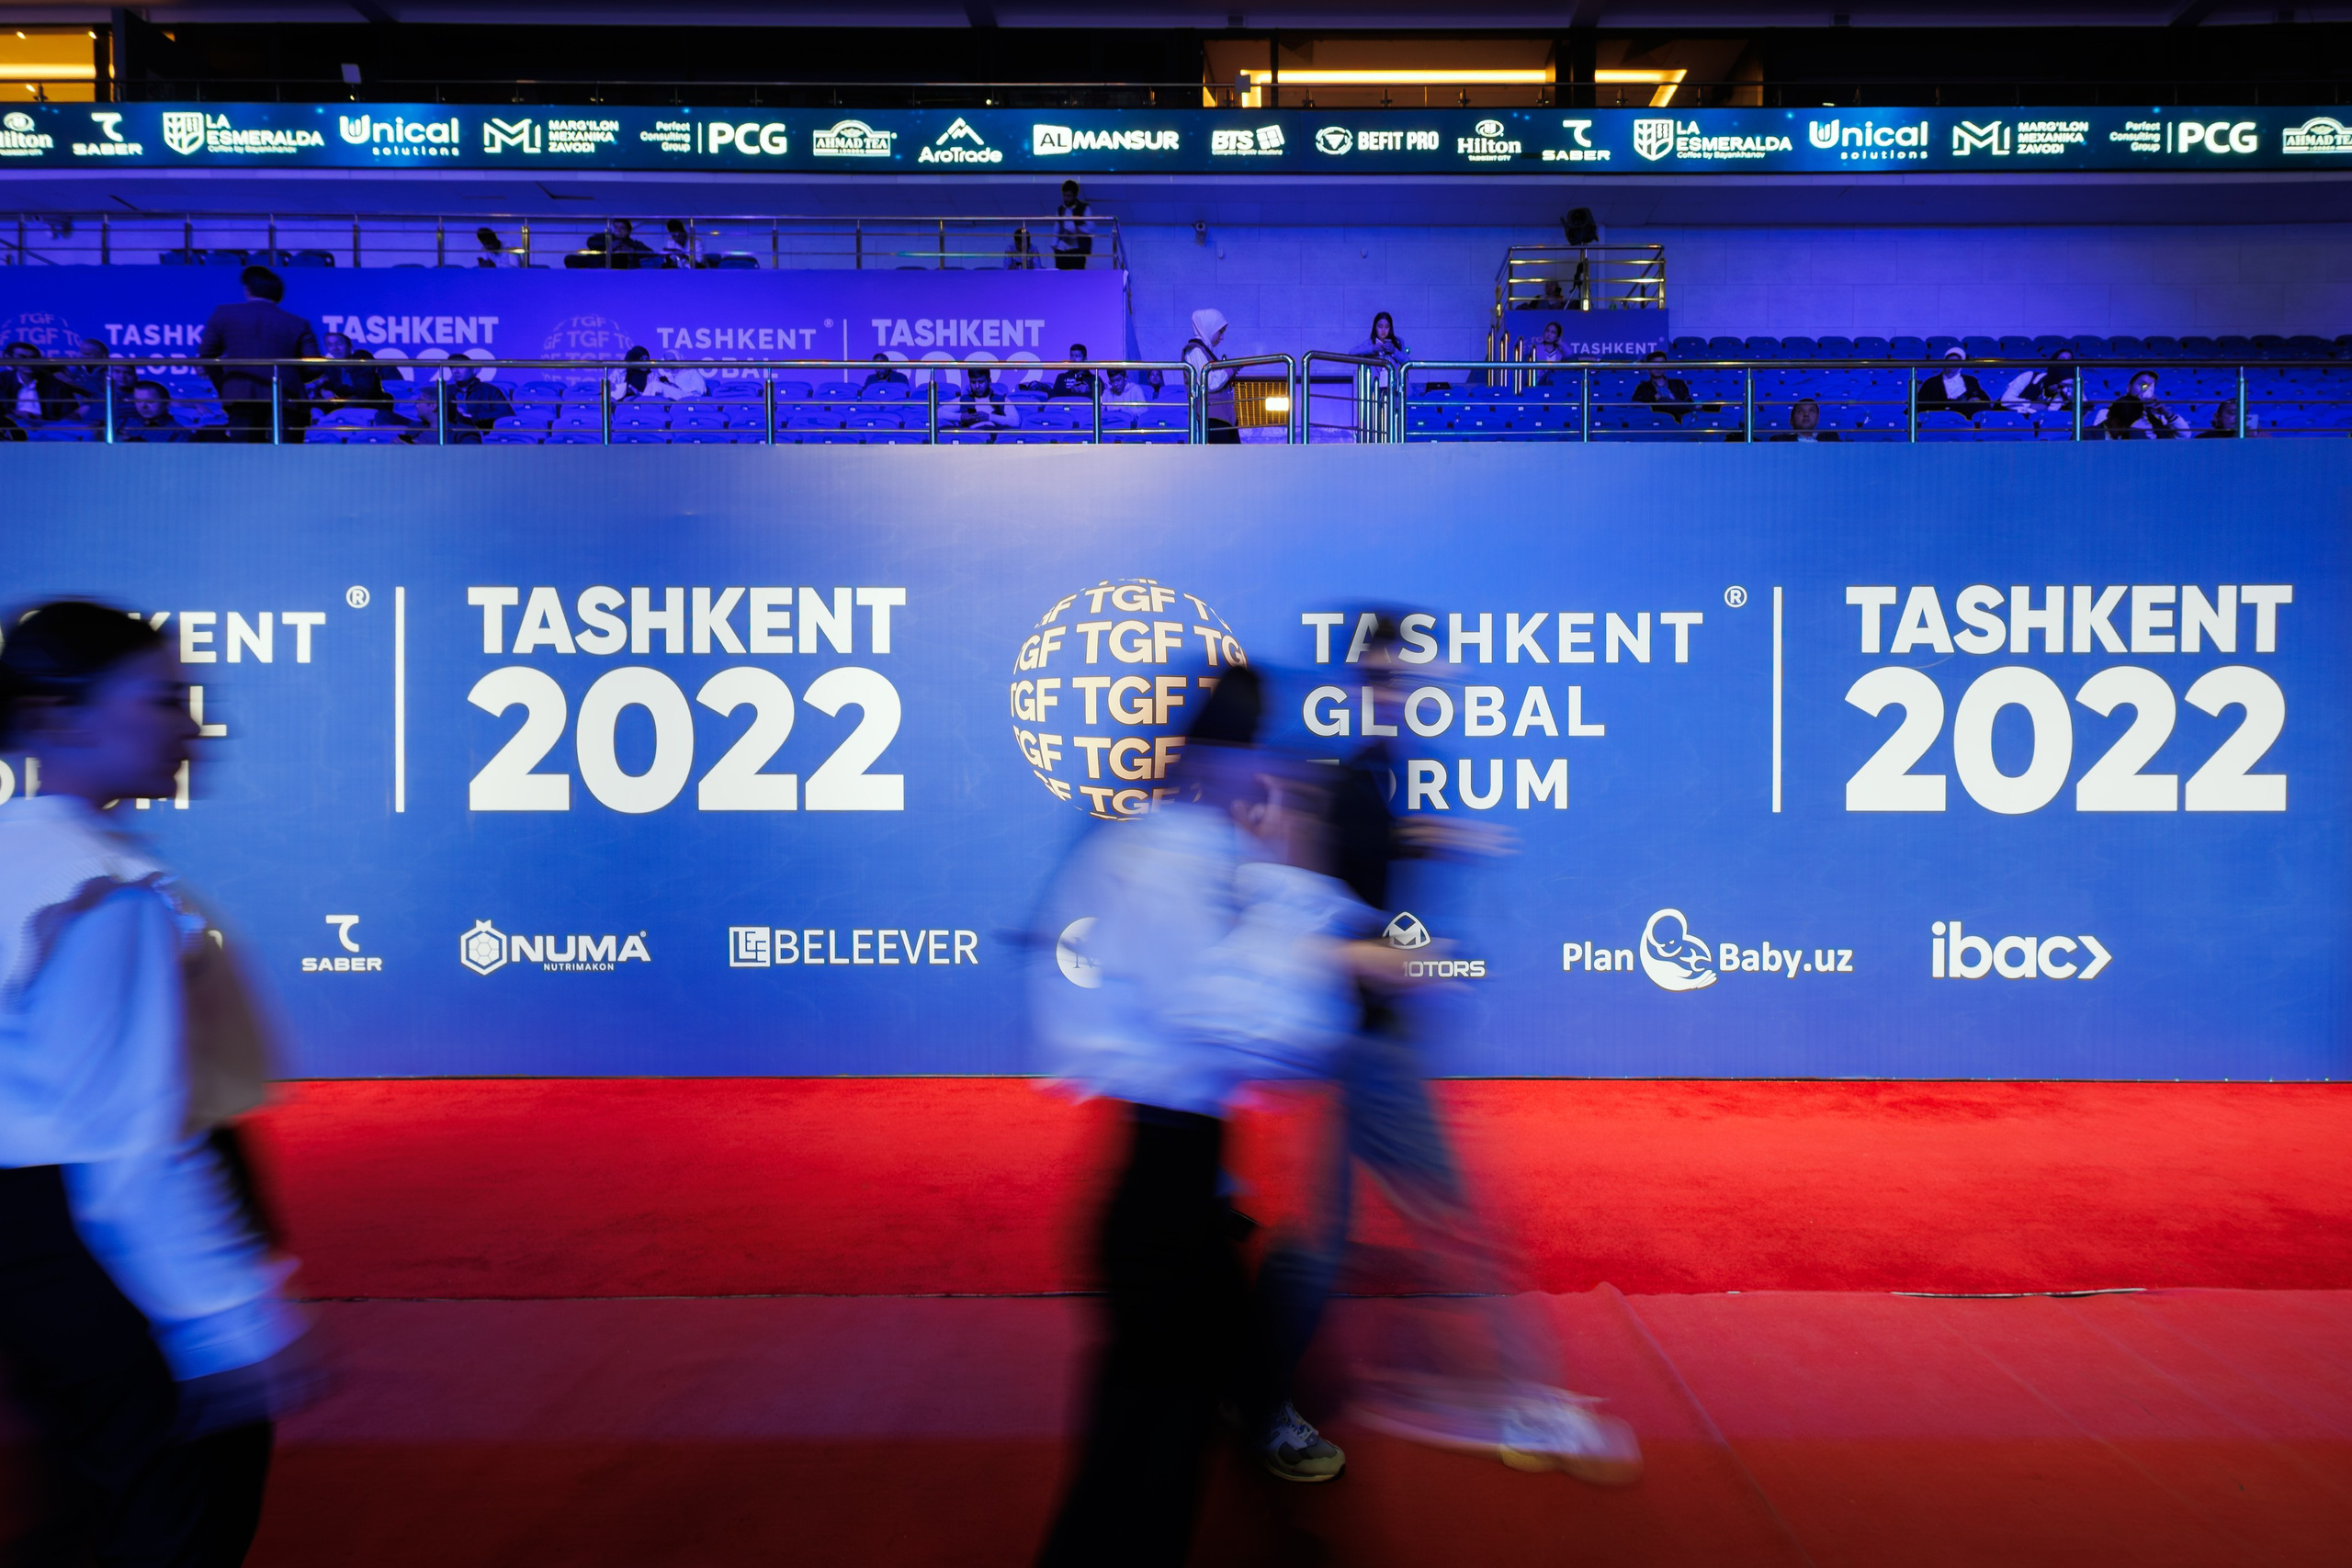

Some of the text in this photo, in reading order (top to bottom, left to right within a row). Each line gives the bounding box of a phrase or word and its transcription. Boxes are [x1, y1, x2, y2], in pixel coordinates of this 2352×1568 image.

[206, 114, 231, 129] LA
[339, 114, 459, 144] Unical
[656, 121, 691, 131] Perfect
[1677, 120, 1700, 135] LA
[2125, 121, 2161, 131] Perfect
[207, 130, 325, 146] ESMERALDA
[548, 131, 615, 142] MEXANIKA
[639, 131, 691, 142] Consulting
[708, 122, 788, 154] PCG
[1072, 130, 1180, 151] MANSUR
[1212, 130, 1254, 150] BTS
[1358, 130, 1440, 151] BEFIT PRO
[1809, 119, 1928, 149] Unical
[2018, 132, 2085, 143] MEXANIKA
[2109, 131, 2161, 142] Consulting
[2178, 121, 2258, 153] PCG
[2286, 134, 2335, 146] AHMAD
[73, 143, 142, 155] SABER
[372, 145, 459, 156] solutions
[548, 141, 595, 152] ZAVODI
[662, 141, 691, 152] Group
[816, 138, 888, 149] AHMAD TEA
[1457, 137, 1522, 154] Hilton
[1677, 136, 1792, 152] ESMERALDA
[2017, 143, 2064, 154] ZAVODI
[2131, 141, 2161, 152] Group
[918, 146, 1003, 163] AroTrade
[1542, 150, 1611, 161] SABER
[1702, 152, 1713, 160] by
[1840, 150, 1928, 160] solutions
[16, 327, 58, 345] TGF
[105, 324, 205, 346] TASHK
[322, 315, 499, 344] TASHKENT
[872, 319, 1045, 347] TASHKENT
[567, 331, 610, 348] TGF
[657, 327, 816, 350] TASHKENT
[1570, 343, 1657, 355] TASHKENT
[1085, 584, 1176, 614] TGF
[467, 585, 907, 655] TASHKENT
[1845, 584, 2293, 655] TASHKENT
[1076, 620, 1183, 664] TGF
[1301, 612, 1703, 664] TASHKENT
[1072, 675, 1187, 725] TGF
[1301, 685, 1606, 738] GLOBAL
[467, 666, 906, 814] 2022
[1844, 665, 2288, 815] 2022
[1073, 736, 1186, 781] TGF
[1306, 759, 1568, 810] RUM
[511, 935, 652, 963] NUMA
[775, 929, 979, 964] BELEEVER
[1931, 920, 2078, 980] ibac
[301, 958, 382, 972] SABER
[543, 963, 615, 972] NUTRIMAKON
[1563, 942, 1854, 979] Plan Baby.uz
